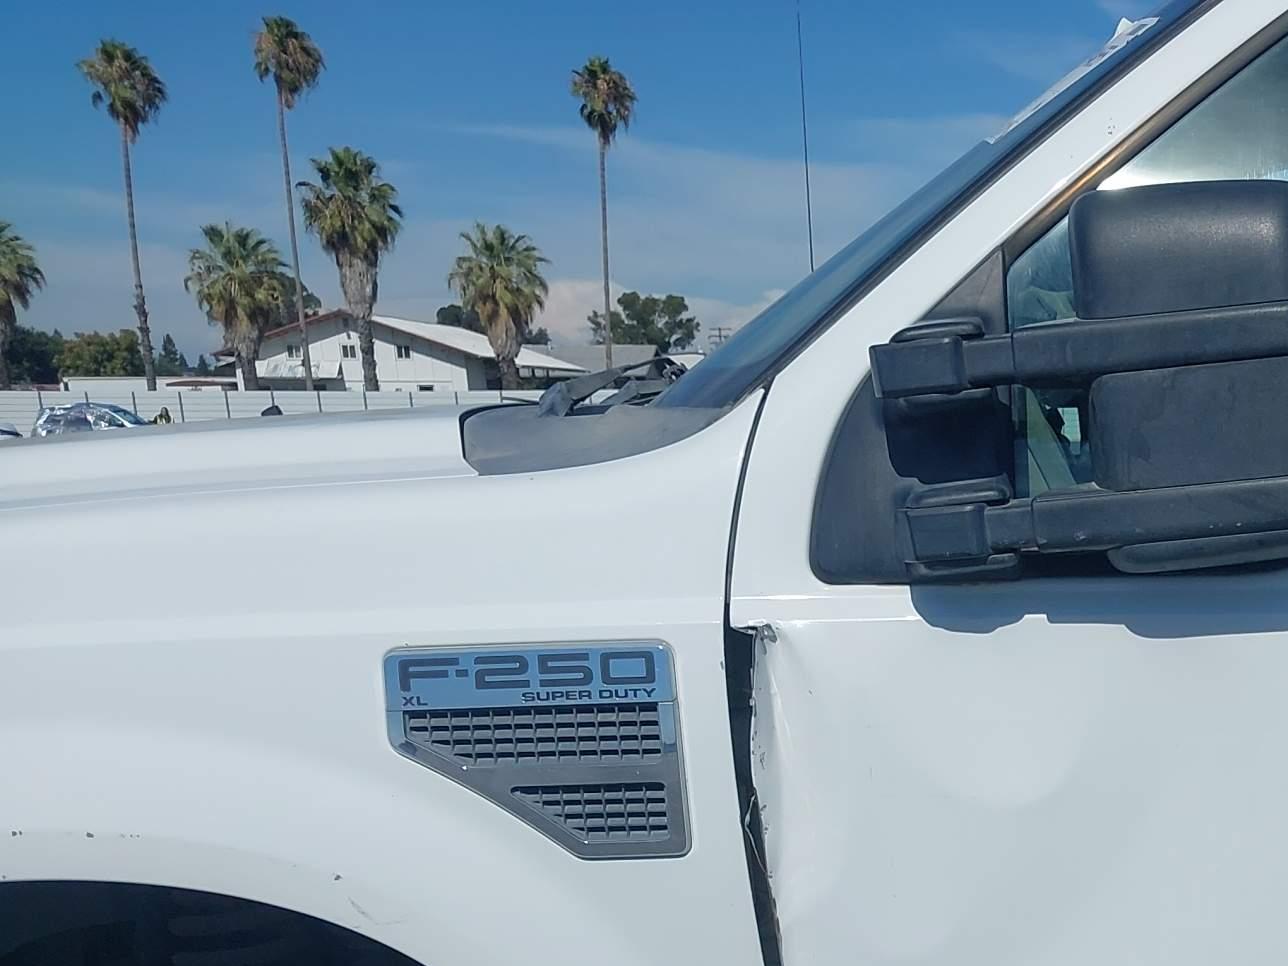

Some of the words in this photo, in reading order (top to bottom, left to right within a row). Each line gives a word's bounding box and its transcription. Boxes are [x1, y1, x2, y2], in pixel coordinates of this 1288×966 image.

[398, 651, 656, 691] F-250
[401, 695, 428, 706] XL
[521, 688, 592, 702] SUPER
[598, 687, 656, 699] DUTY
